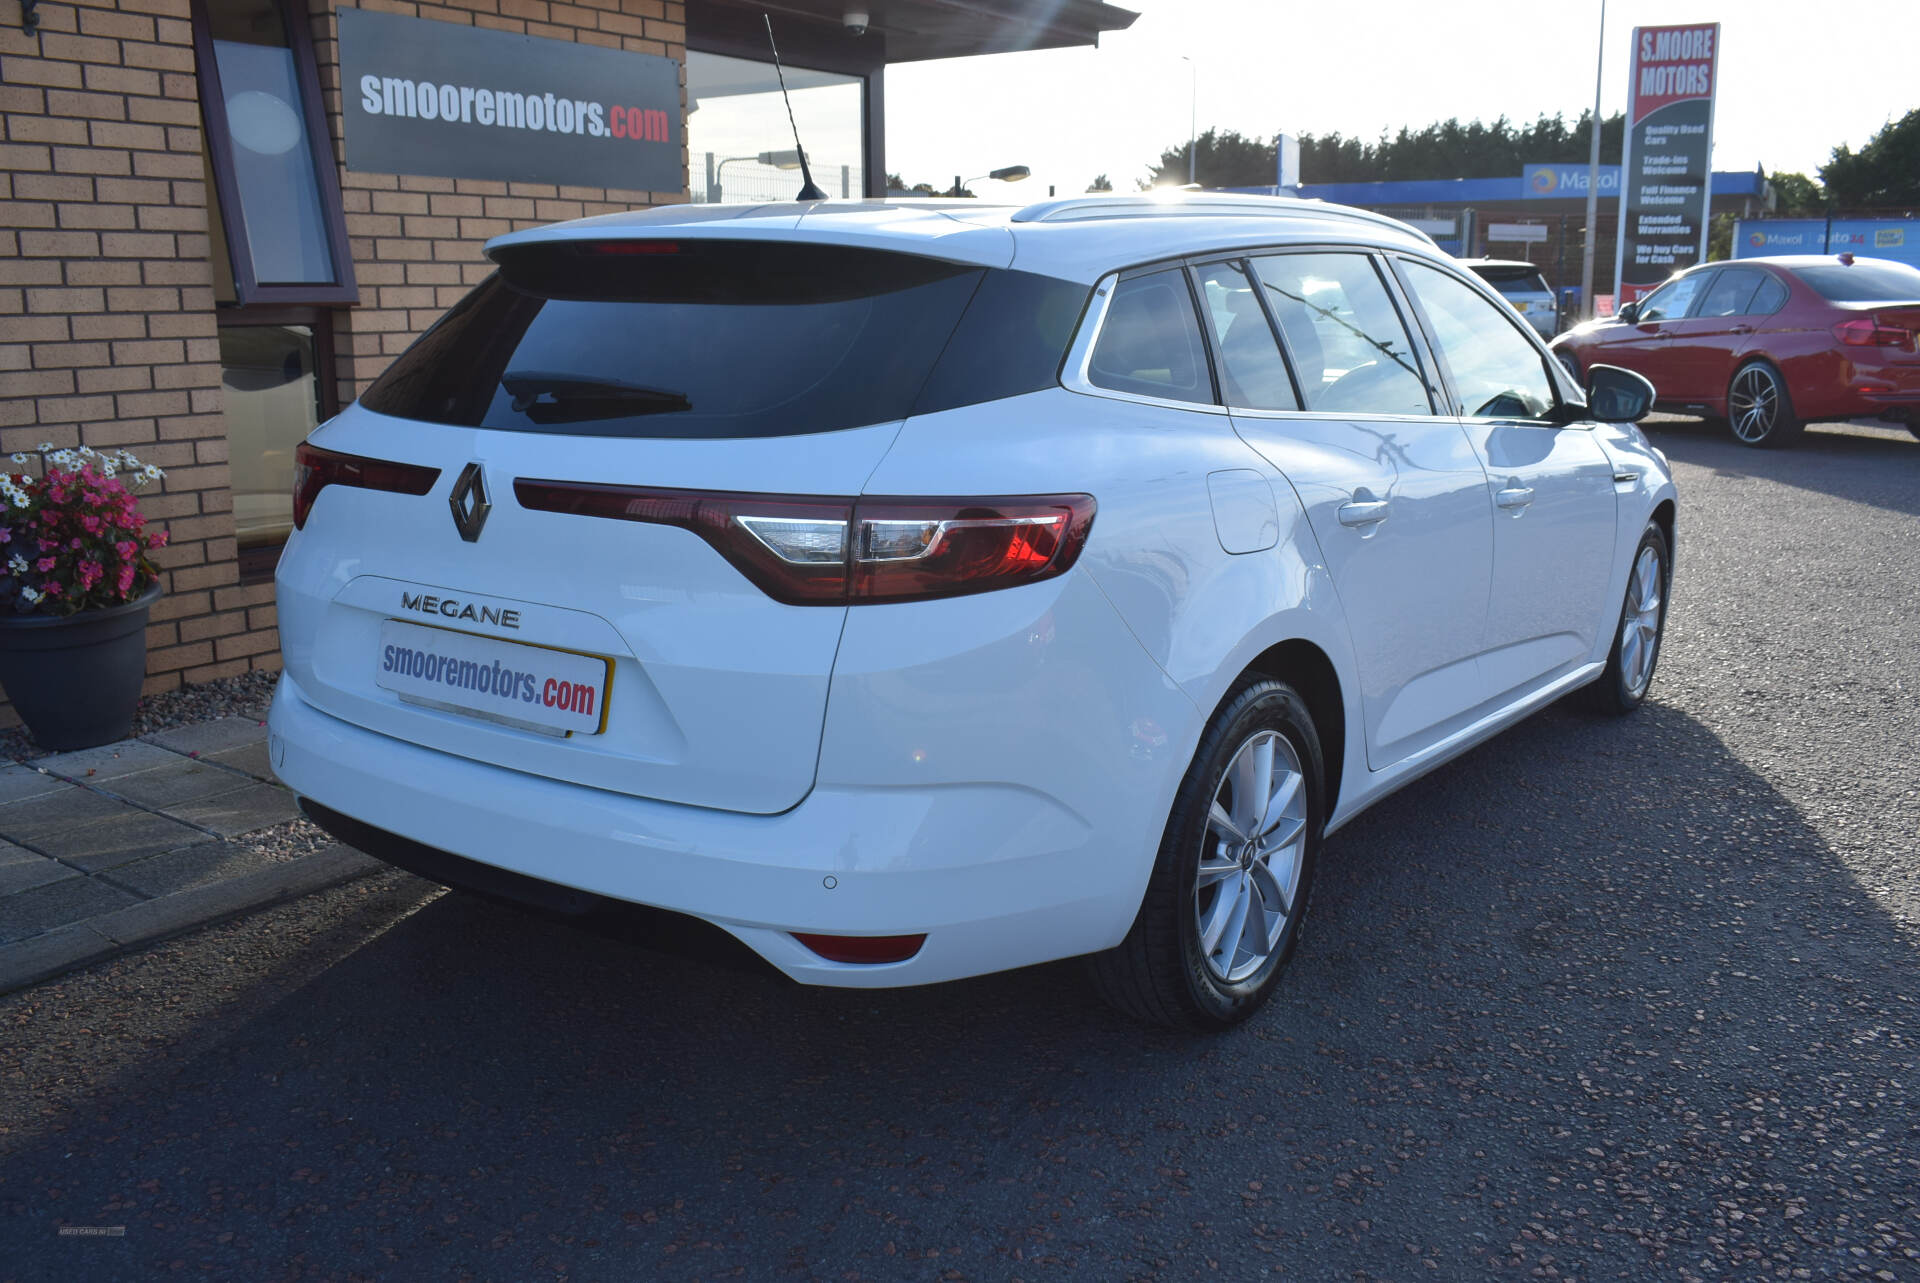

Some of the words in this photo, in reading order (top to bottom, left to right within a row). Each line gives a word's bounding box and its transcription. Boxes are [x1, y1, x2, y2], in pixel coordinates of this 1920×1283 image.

[1641, 29, 1713, 62] S.MOORE
[1640, 64, 1708, 96] MOTORS
[360, 74, 669, 143] smooremotors.com
[1645, 125, 1679, 135] Quality
[1680, 124, 1704, 134] Used
[1644, 136, 1667, 145] Cars
[1642, 166, 1688, 175] Welcome
[1641, 186, 1658, 195] Full
[1660, 186, 1697, 194] Finance
[1641, 196, 1685, 204] Welcome
[1639, 215, 1682, 224] Extended
[1638, 226, 1691, 235] Warranties
[1636, 245, 1652, 254] We
[1653, 245, 1671, 255] buy
[1671, 245, 1694, 254] Cars
[1635, 255, 1650, 264] for
[1650, 255, 1675, 264] Cash
[401, 592, 521, 629] MEGANE
[383, 644, 595, 716] smooremotors.com
